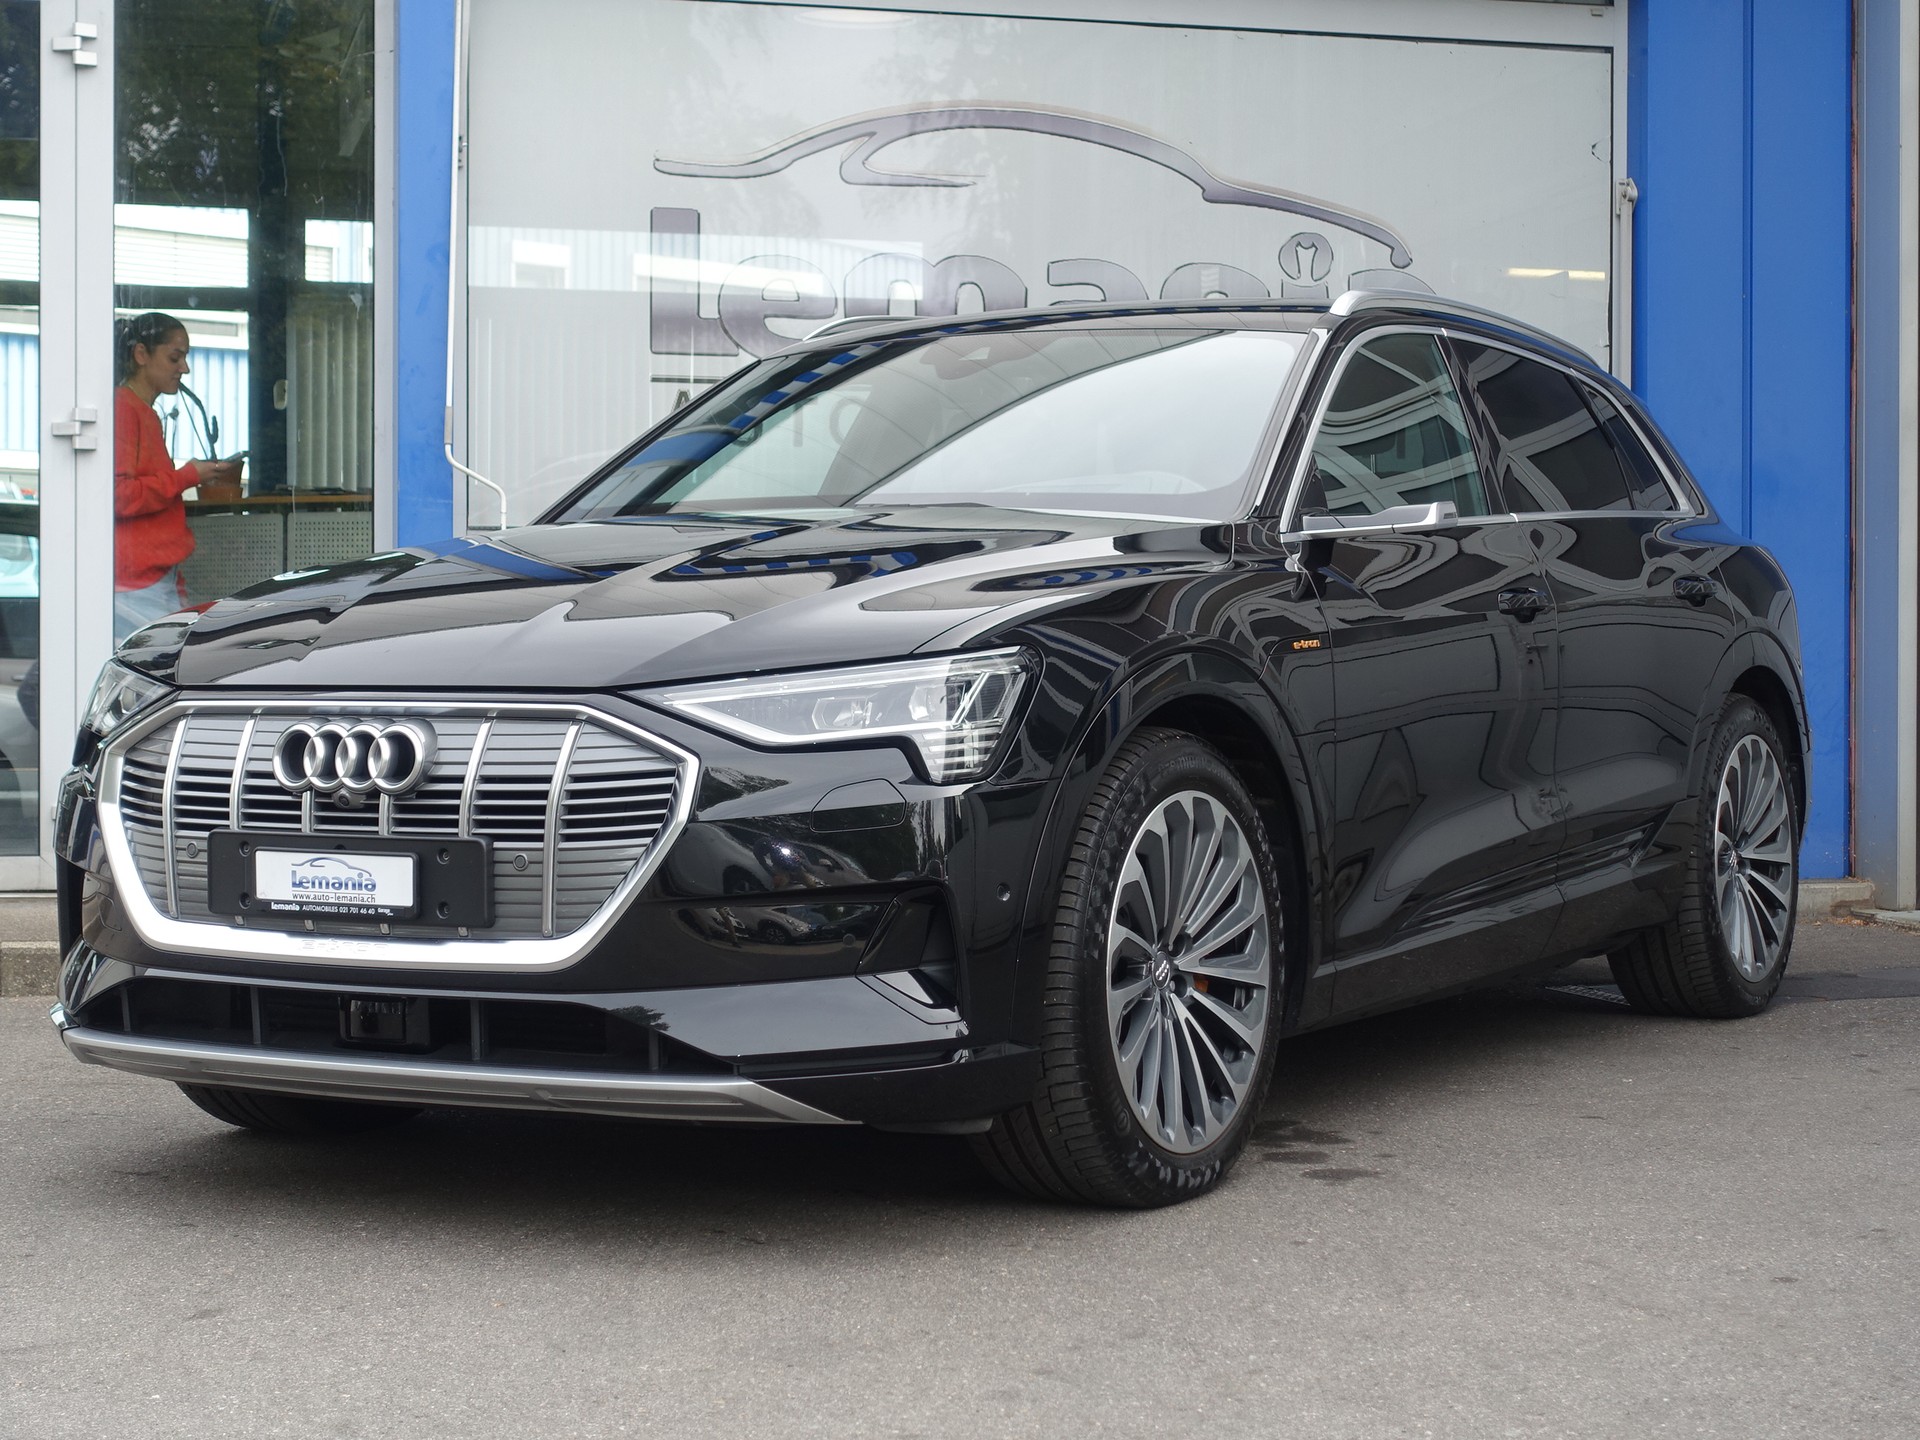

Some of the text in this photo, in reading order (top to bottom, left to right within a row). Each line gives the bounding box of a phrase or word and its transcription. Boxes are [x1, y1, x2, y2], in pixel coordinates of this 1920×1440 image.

[1293, 640, 1321, 650] e-tron
[291, 870, 377, 892] Lemania
[292, 892, 376, 903] www.auto-lemania.ch
[302, 904, 338, 913] AUTOMOBILES
[339, 906, 349, 914] 021
[360, 907, 368, 915] 46
